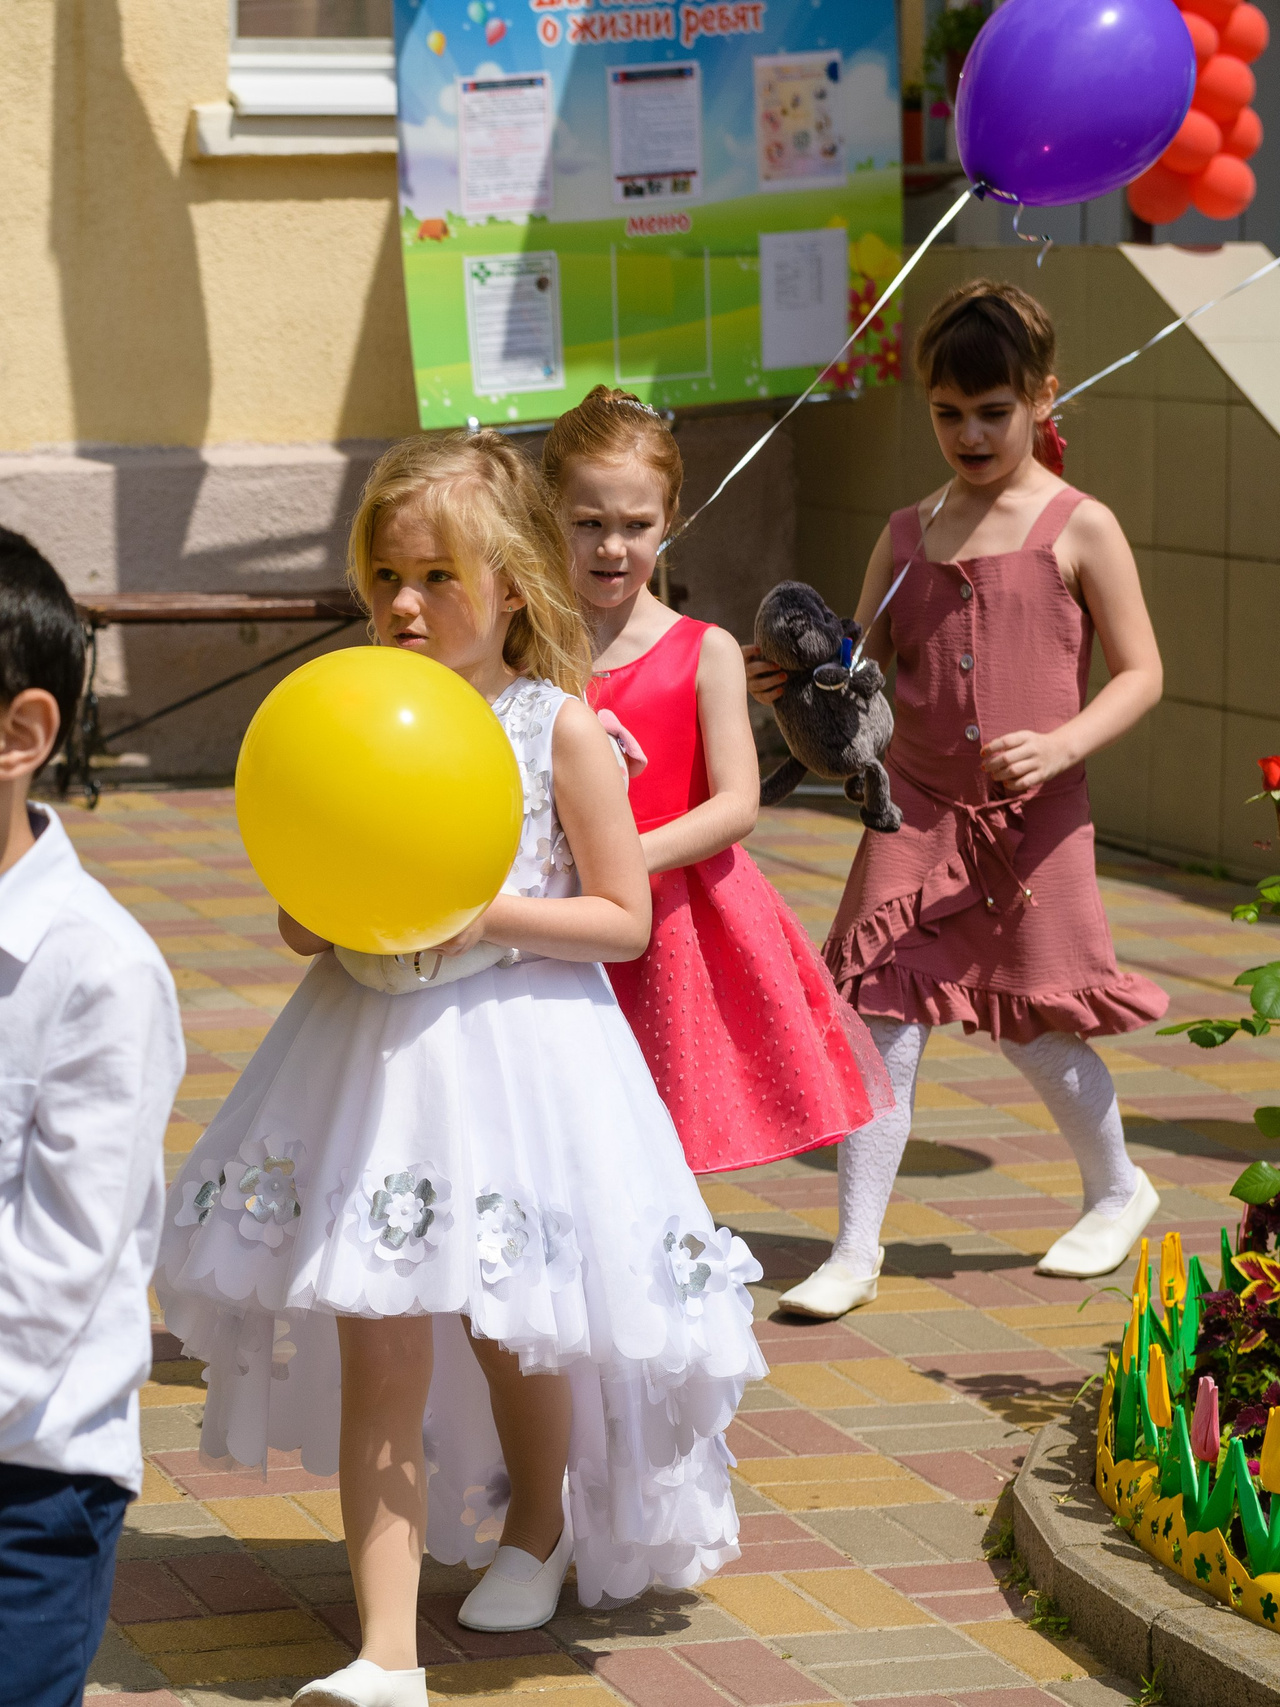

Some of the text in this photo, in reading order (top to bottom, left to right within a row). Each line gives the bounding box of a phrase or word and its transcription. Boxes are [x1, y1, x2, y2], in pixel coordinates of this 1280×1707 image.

[538, 14, 562, 47] о
[569, 9, 674, 43] жизни
[681, 3, 764, 47] ребят
